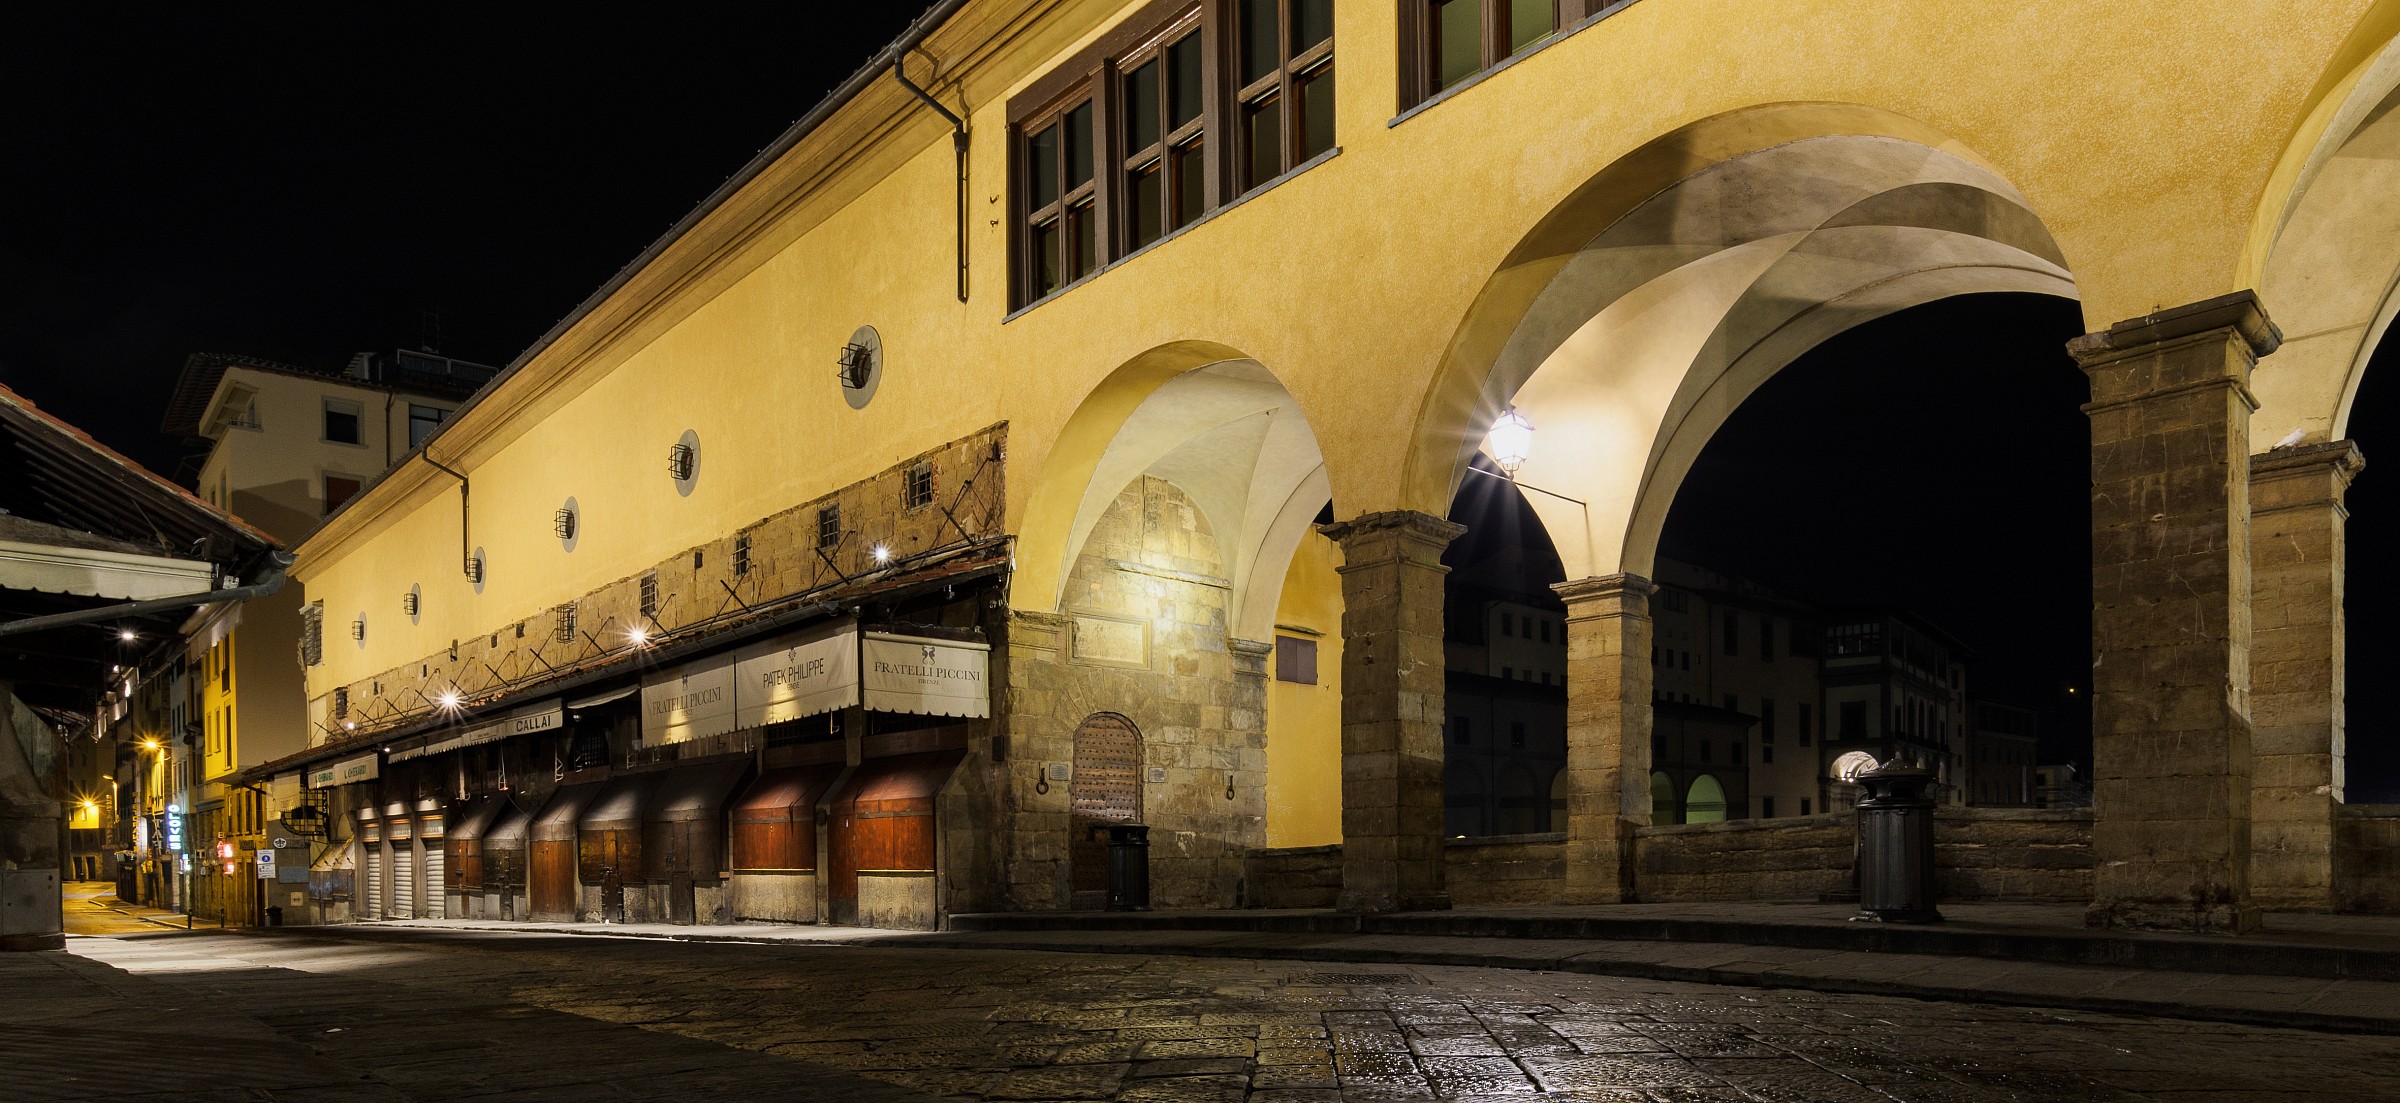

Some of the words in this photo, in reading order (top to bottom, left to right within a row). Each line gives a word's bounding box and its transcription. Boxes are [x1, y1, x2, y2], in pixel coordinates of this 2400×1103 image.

[763, 668, 787, 688] PATEK
[788, 658, 824, 682] PHILIPPE
[874, 662, 933, 677] FRATELLI
[936, 667, 981, 681] PICCINI
[653, 695, 688, 715] FRATELLI
[690, 687, 721, 707] PICCINI
[516, 715, 551, 732] CALLAI
[168, 804, 181, 850] GLOVES
